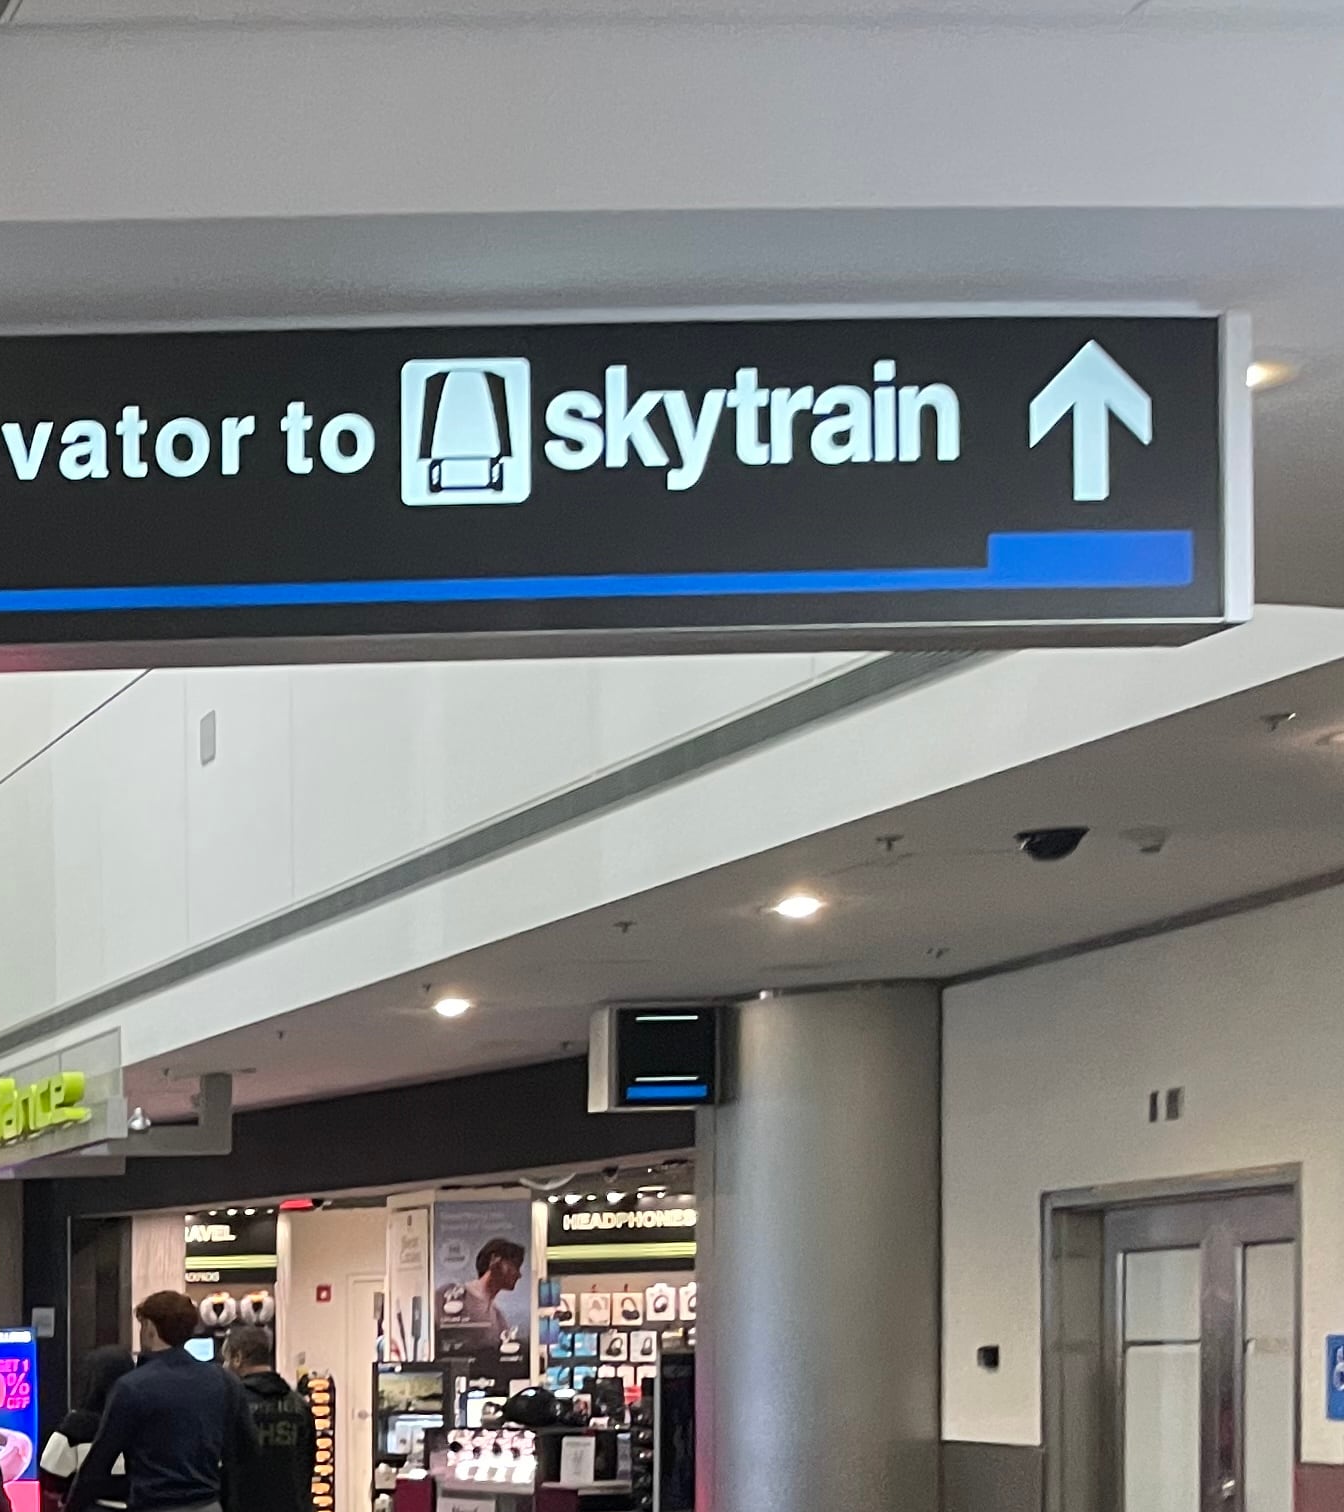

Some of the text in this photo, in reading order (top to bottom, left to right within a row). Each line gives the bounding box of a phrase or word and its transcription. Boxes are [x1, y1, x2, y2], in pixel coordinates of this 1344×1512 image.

[281, 401, 377, 476] to
[543, 359, 962, 492] skytrain
[563, 1209, 697, 1230] HEADPHONES
